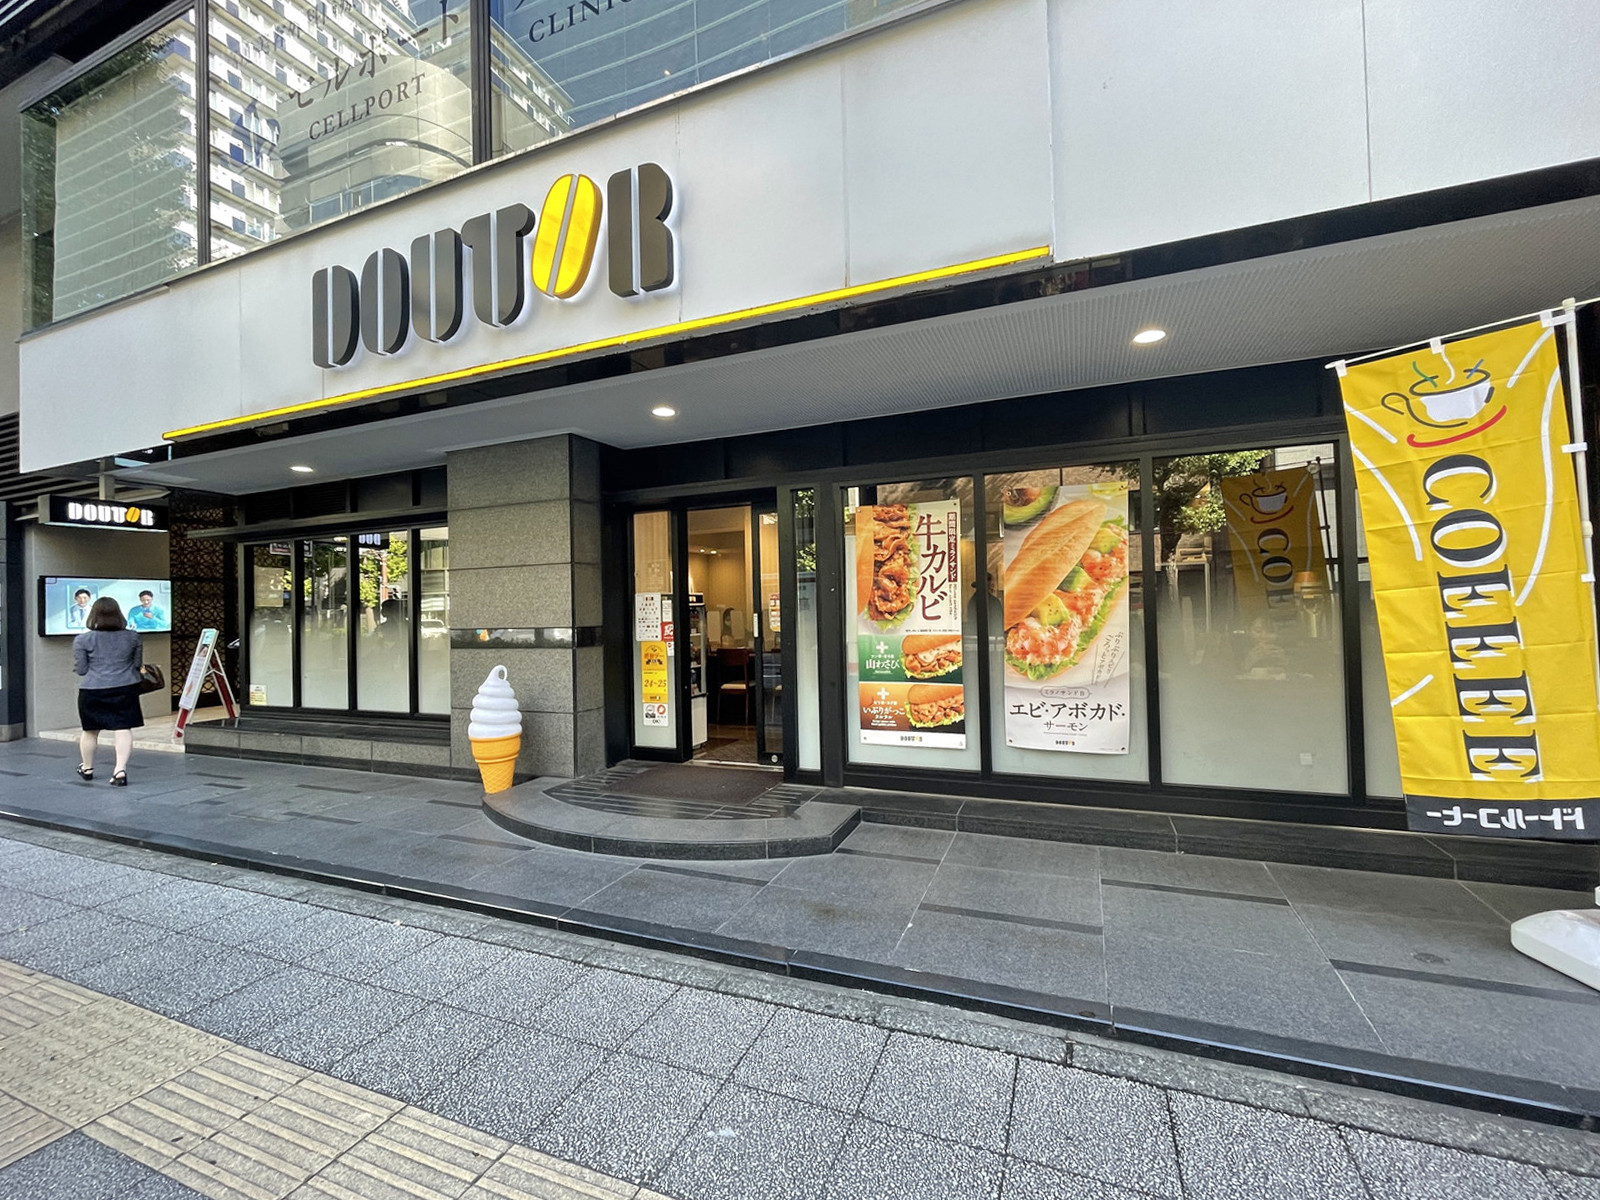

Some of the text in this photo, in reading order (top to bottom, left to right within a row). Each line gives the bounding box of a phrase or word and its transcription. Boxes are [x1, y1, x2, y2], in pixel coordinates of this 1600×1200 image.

[308, 72, 427, 141] CELLPORT
[311, 162, 674, 368] DOUTOR
[67, 501, 155, 526] DOUTOR
[912, 513, 948, 621] 牛カルビ
[866, 658, 900, 670] 山わさび
[862, 706, 906, 716] いぶりがっこ
[1043, 720, 1089, 732] サーモン
